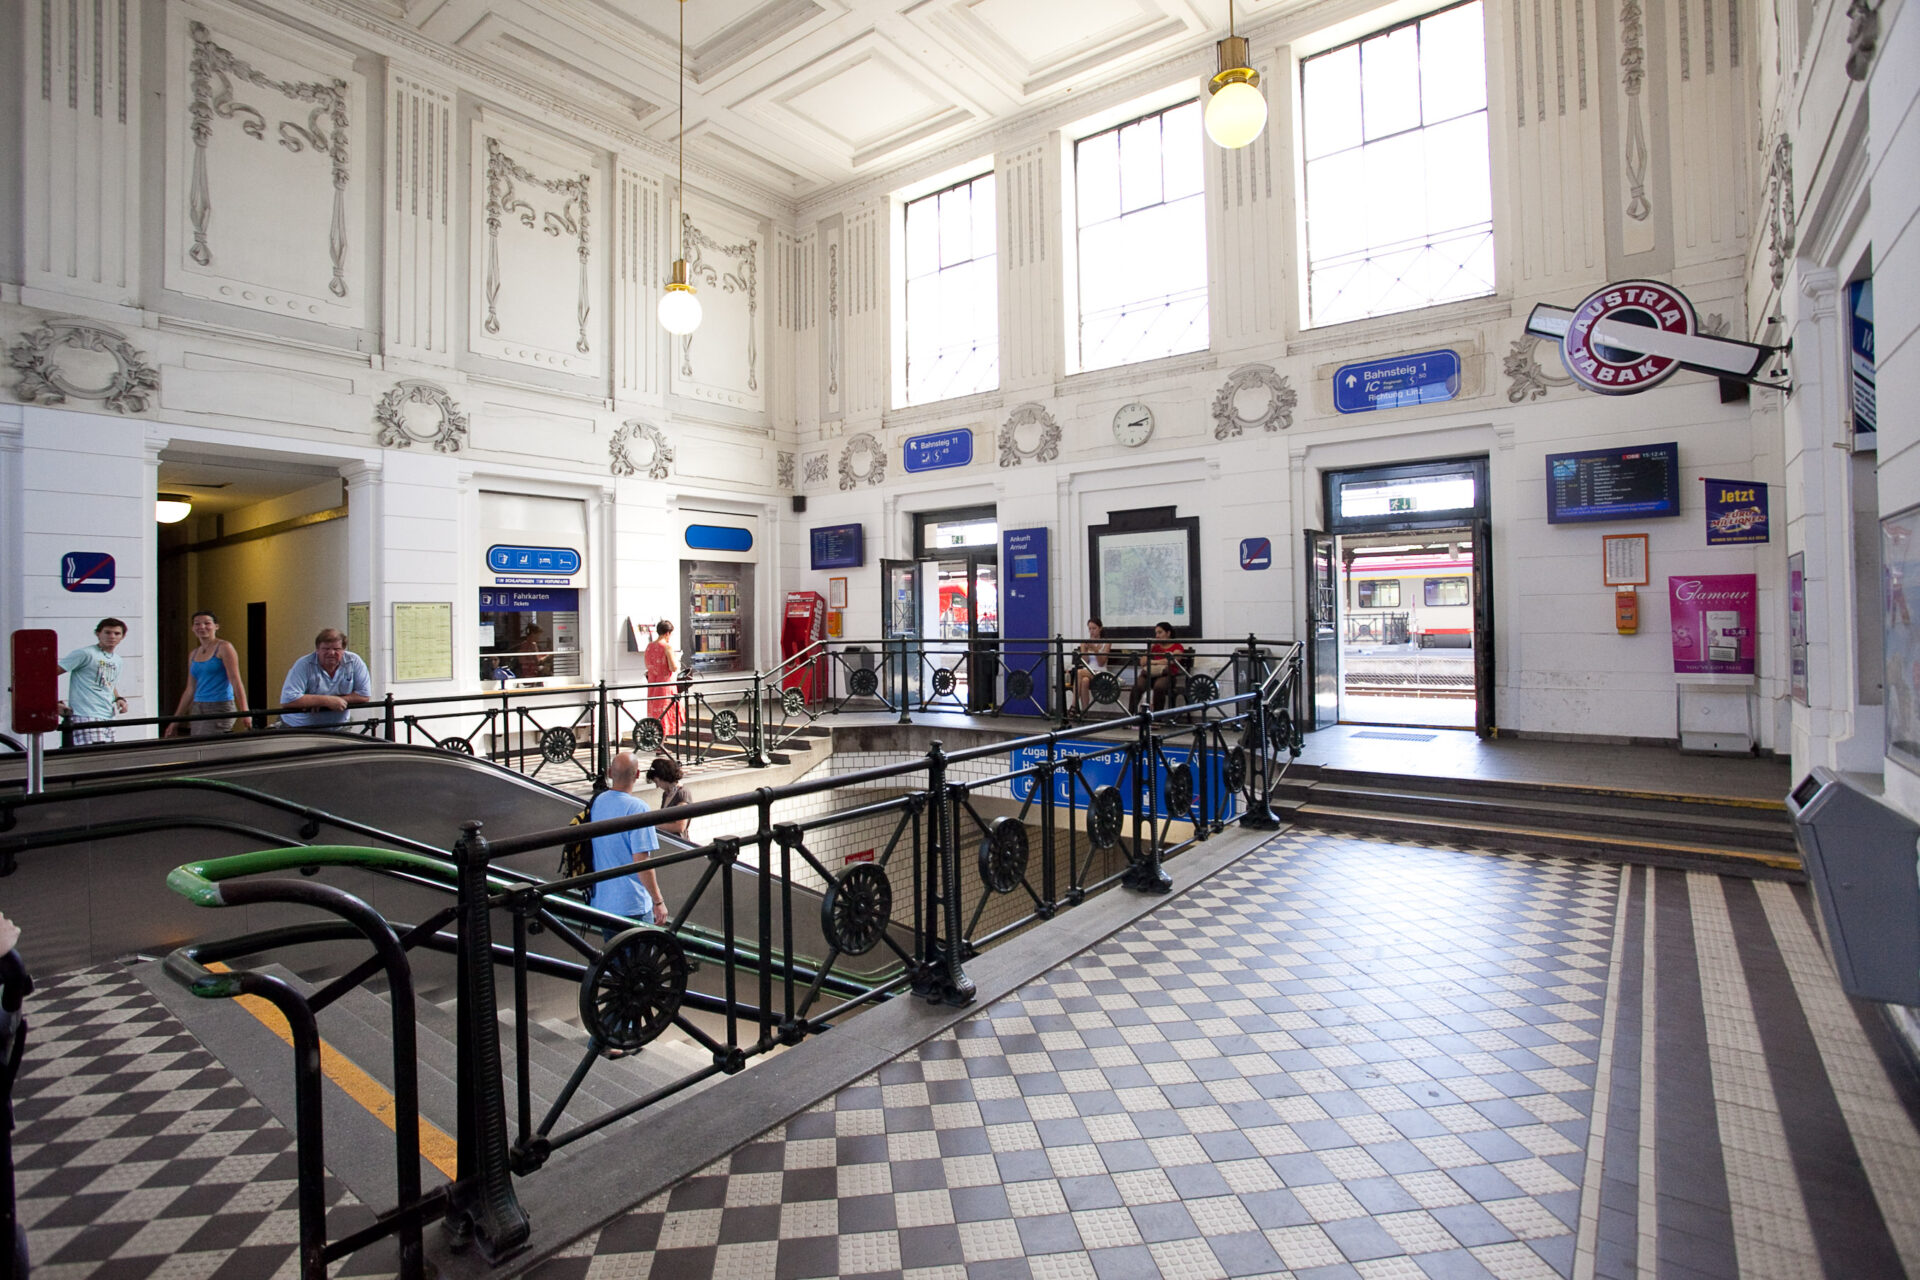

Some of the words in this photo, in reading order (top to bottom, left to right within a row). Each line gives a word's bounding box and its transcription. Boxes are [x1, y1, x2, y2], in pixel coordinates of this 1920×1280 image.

[1575, 289, 1681, 333] AUSTRIA
[1364, 364, 1416, 380] Bahnsteig
[1421, 362, 1427, 372] 1
[1573, 347, 1659, 382] TABAK
[1365, 381, 1380, 392] IC
[1368, 391, 1403, 401] Richtung
[1406, 388, 1423, 396] Linz
[920, 439, 950, 450] Bahnsteig
[952, 437, 958, 445] 11
[1719, 489, 1755, 503] Jetzt
[1725, 511, 1753, 519] EURO
[1010, 534, 1031, 542] Ankunft
[1010, 543, 1028, 551] Arrival
[513, 592, 550, 600] Fahrkarten
[1676, 580, 1750, 601] Glamour
[810, 600, 823, 641] Heute
